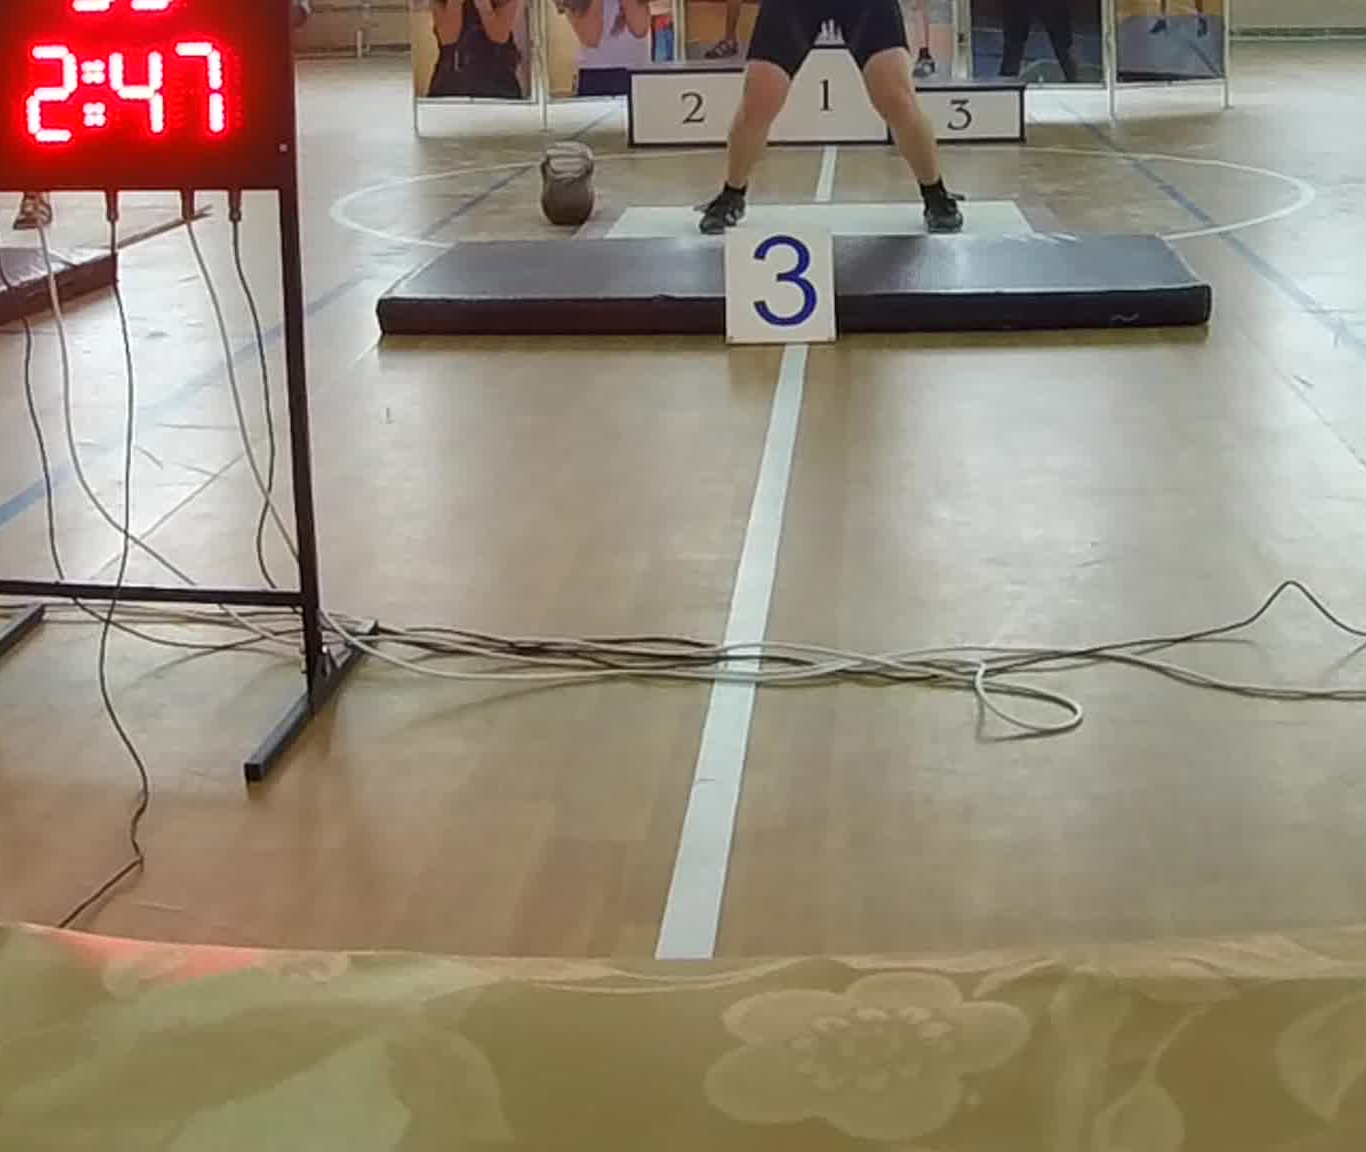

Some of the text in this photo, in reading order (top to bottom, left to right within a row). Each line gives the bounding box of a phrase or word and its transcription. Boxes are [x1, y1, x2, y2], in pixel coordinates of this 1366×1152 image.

[26, 42, 224, 143] 2:47
[681, 92, 705, 124] 2
[819, 79, 832, 111] 1
[947, 99, 972, 130] 3
[754, 234, 817, 326] 3
